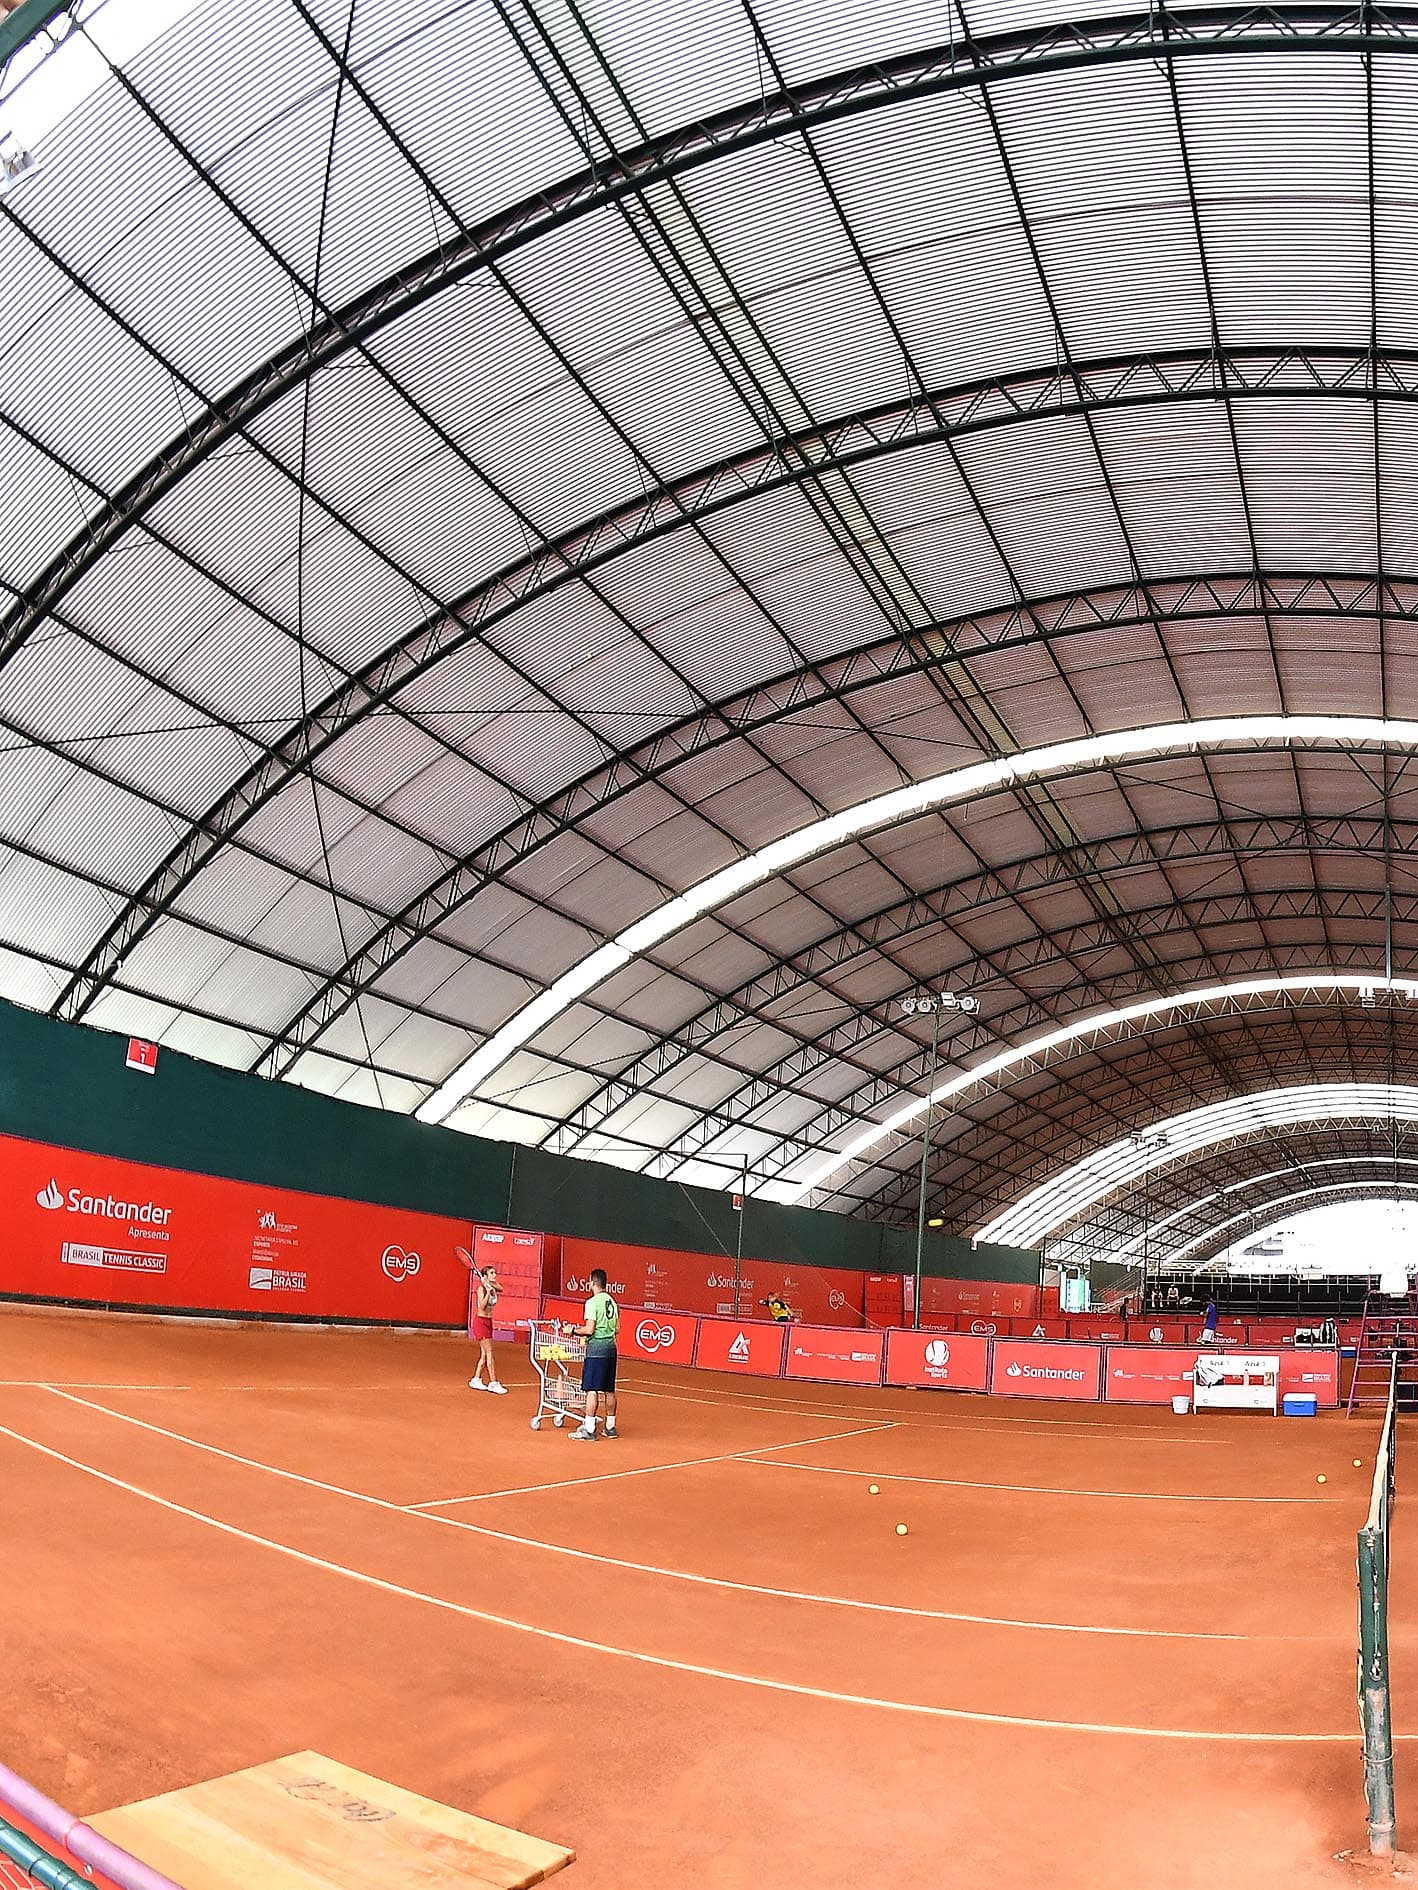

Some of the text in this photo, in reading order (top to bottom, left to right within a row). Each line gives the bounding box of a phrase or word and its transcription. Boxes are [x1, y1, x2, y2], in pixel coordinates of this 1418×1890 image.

[67, 1188, 172, 1225] Santander
[128, 1226, 170, 1241] Apresenta
[72, 1248, 164, 1269] BRASIL TENNIS CLASSIC
[385, 1256, 417, 1270] EMS
[272, 1276, 306, 1289] BRASIL
[579, 1278, 626, 1294] Sander
[640, 1329, 671, 1342] EMS
[1022, 1365, 1085, 1381] Santander
